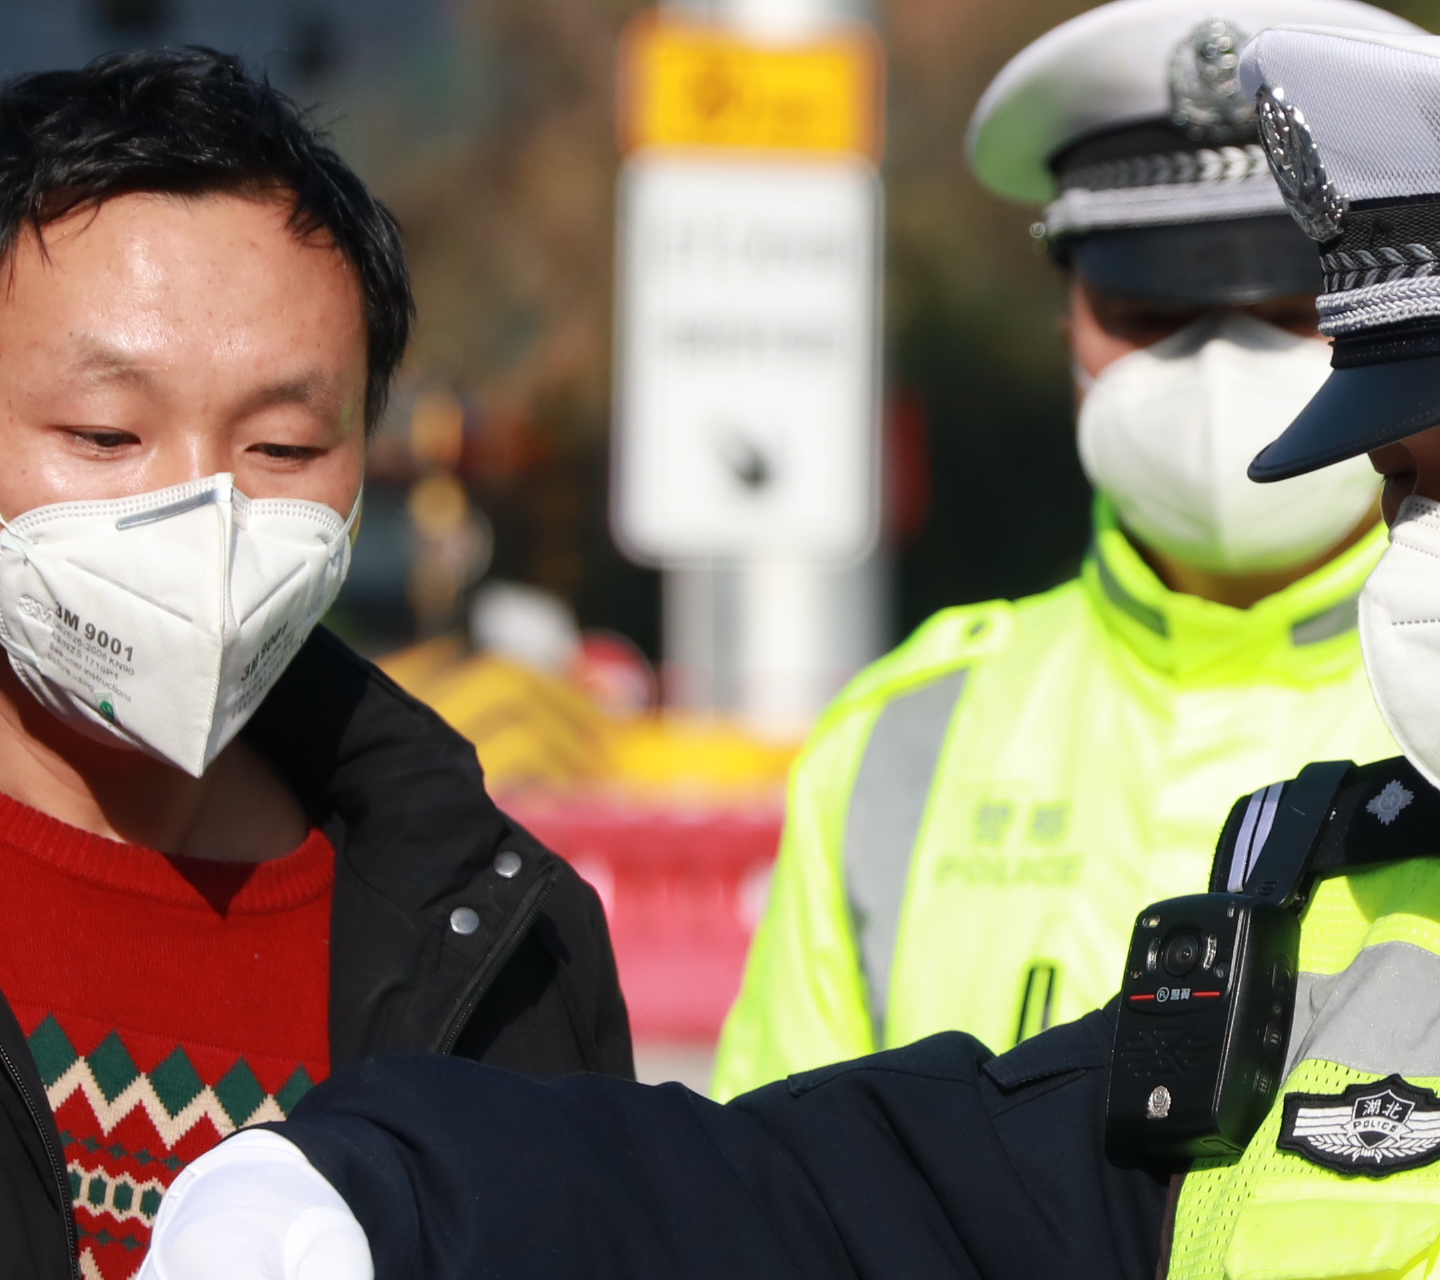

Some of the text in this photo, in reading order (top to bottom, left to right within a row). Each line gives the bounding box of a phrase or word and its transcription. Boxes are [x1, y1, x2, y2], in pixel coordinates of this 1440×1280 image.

[85, 622, 134, 663] 9001
[83, 667, 132, 702] instructions
[1362, 1098, 1403, 1120] 湖北
[1352, 1120, 1398, 1133] POLICE
